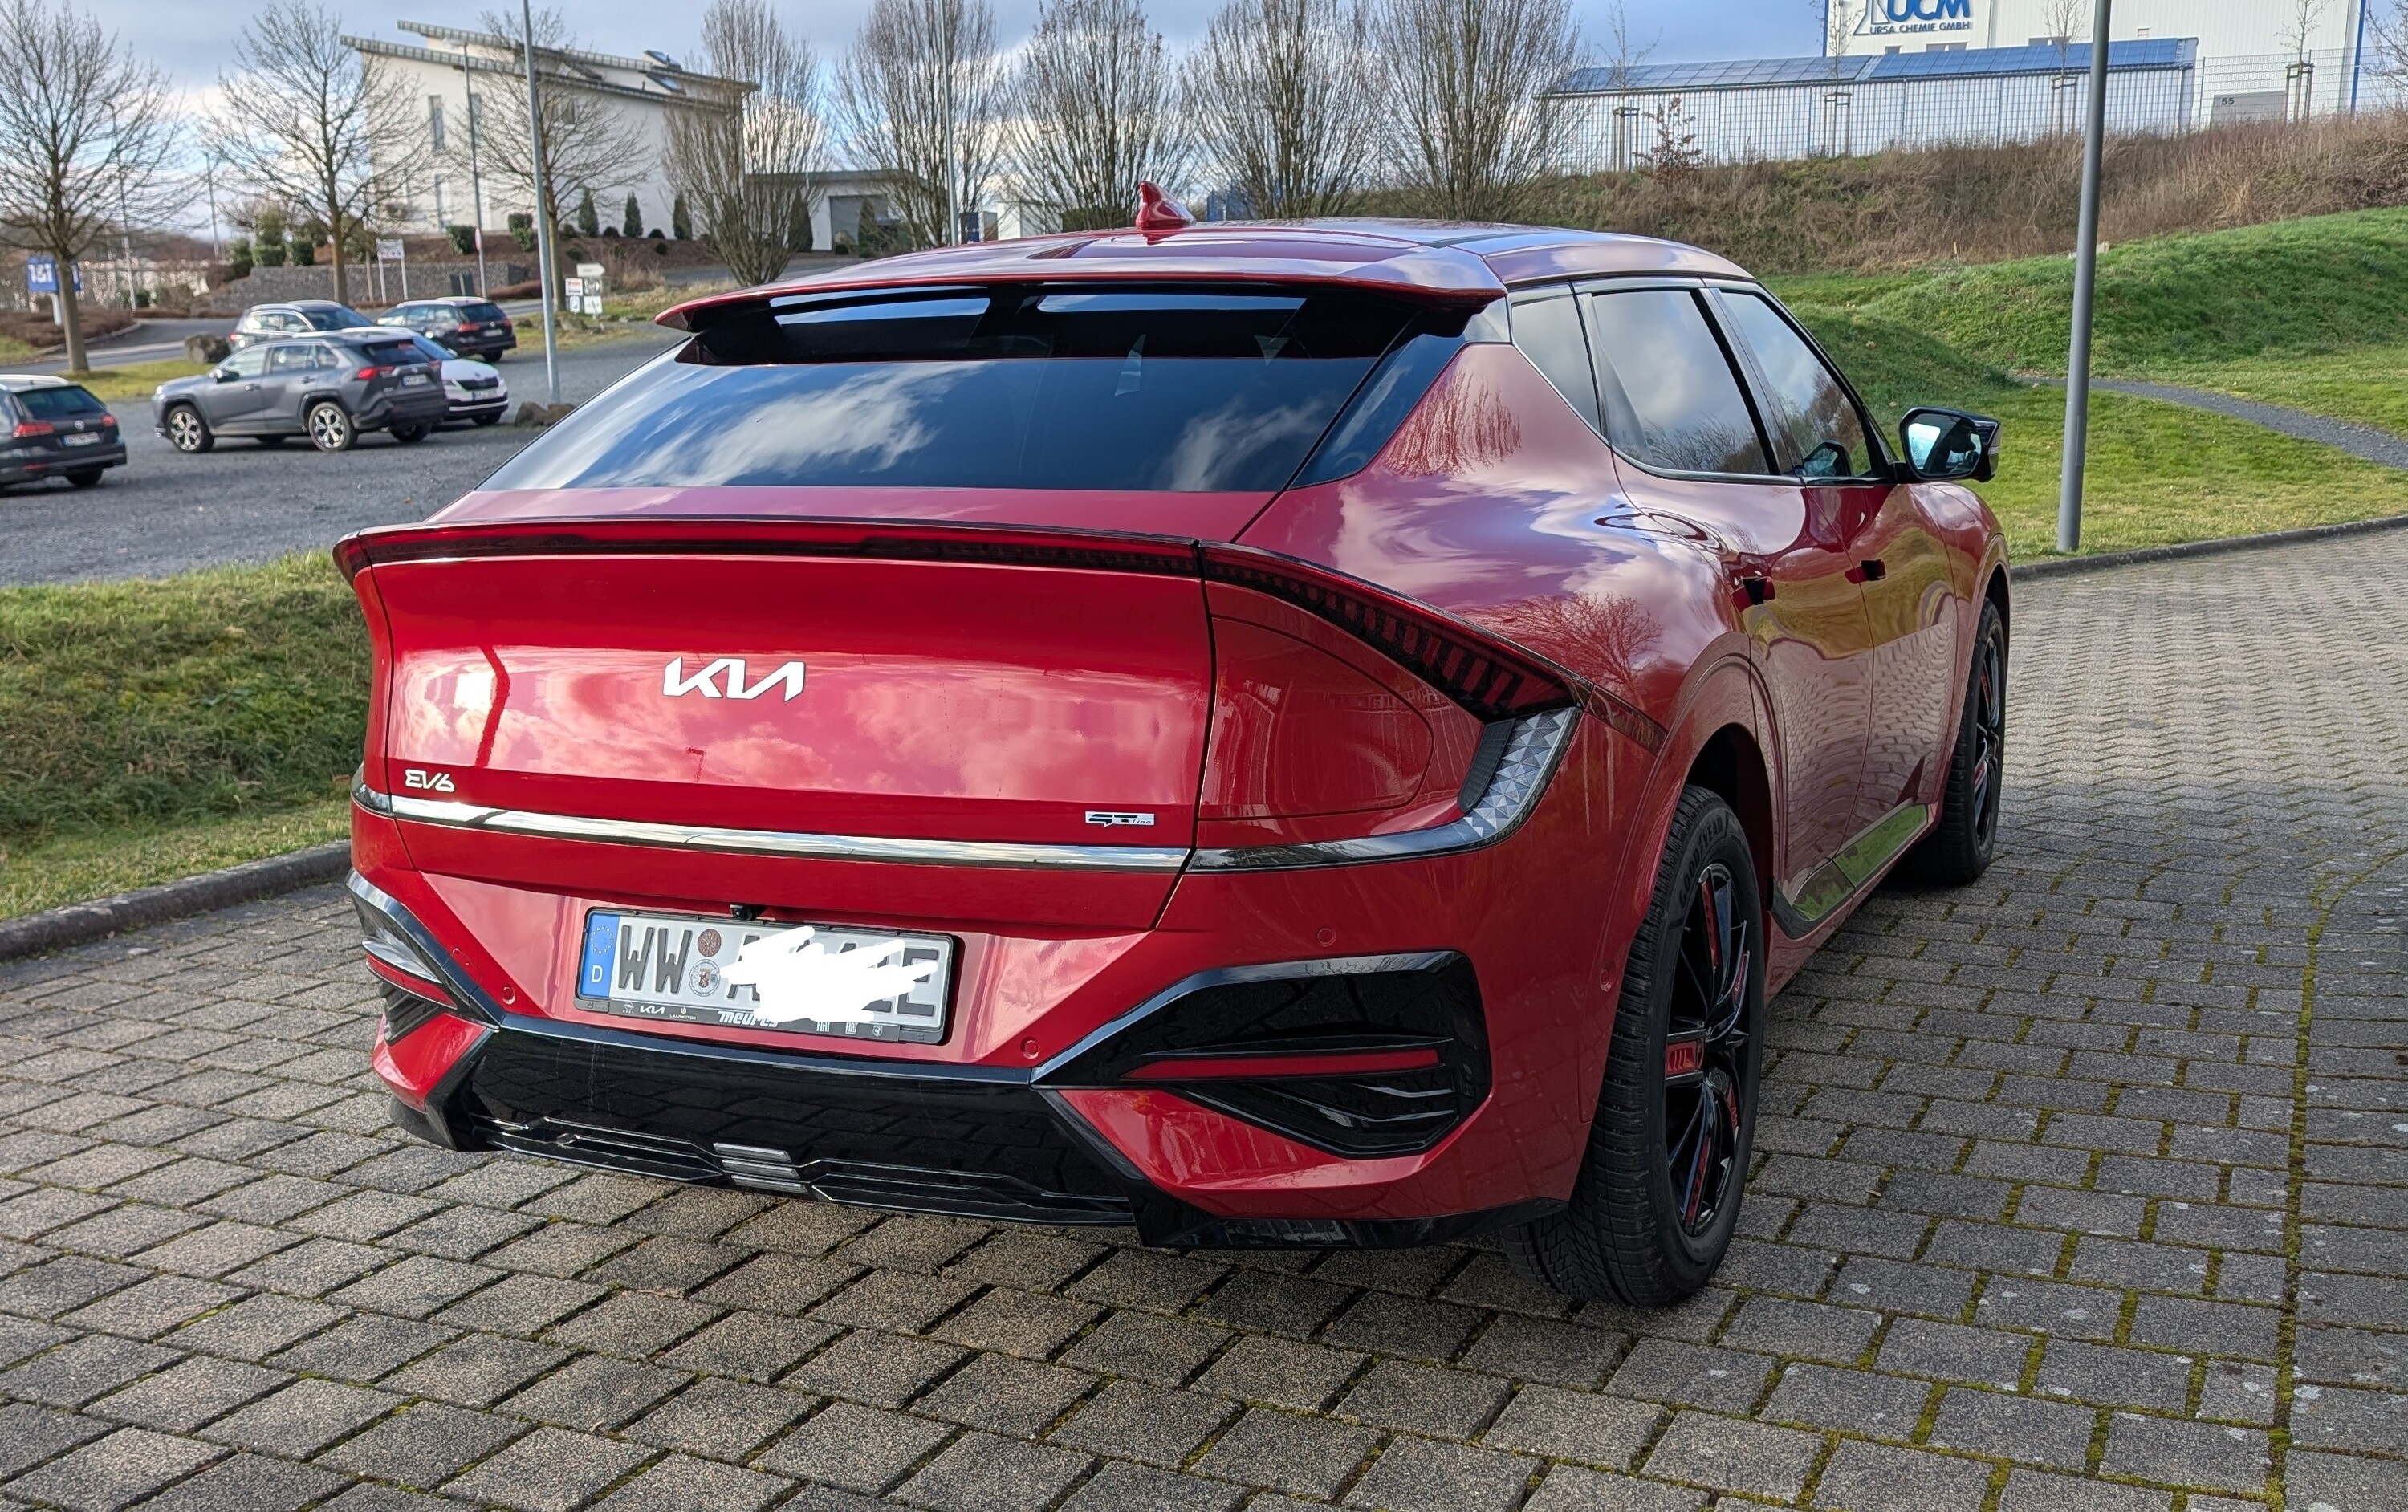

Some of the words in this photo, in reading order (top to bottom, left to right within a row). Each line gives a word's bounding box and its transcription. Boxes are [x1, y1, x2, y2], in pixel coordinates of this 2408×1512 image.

[1887, 0, 1970, 22] UCM
[1869, 25, 1895, 35] URSA
[1899, 22, 1935, 34] CHEMIE
[1939, 21, 1970, 31] GMBH
[2221, 97, 2235, 105] 55
[662, 656, 807, 702] KIA
[405, 768, 456, 793] EV6
[1679, 816, 1723, 908] GOODYEAR
[591, 965, 603, 983] D
[618, 925, 694, 994] WW
[816, 1021, 831, 1033] FIAT
[845, 1022, 859, 1034] FIAT
